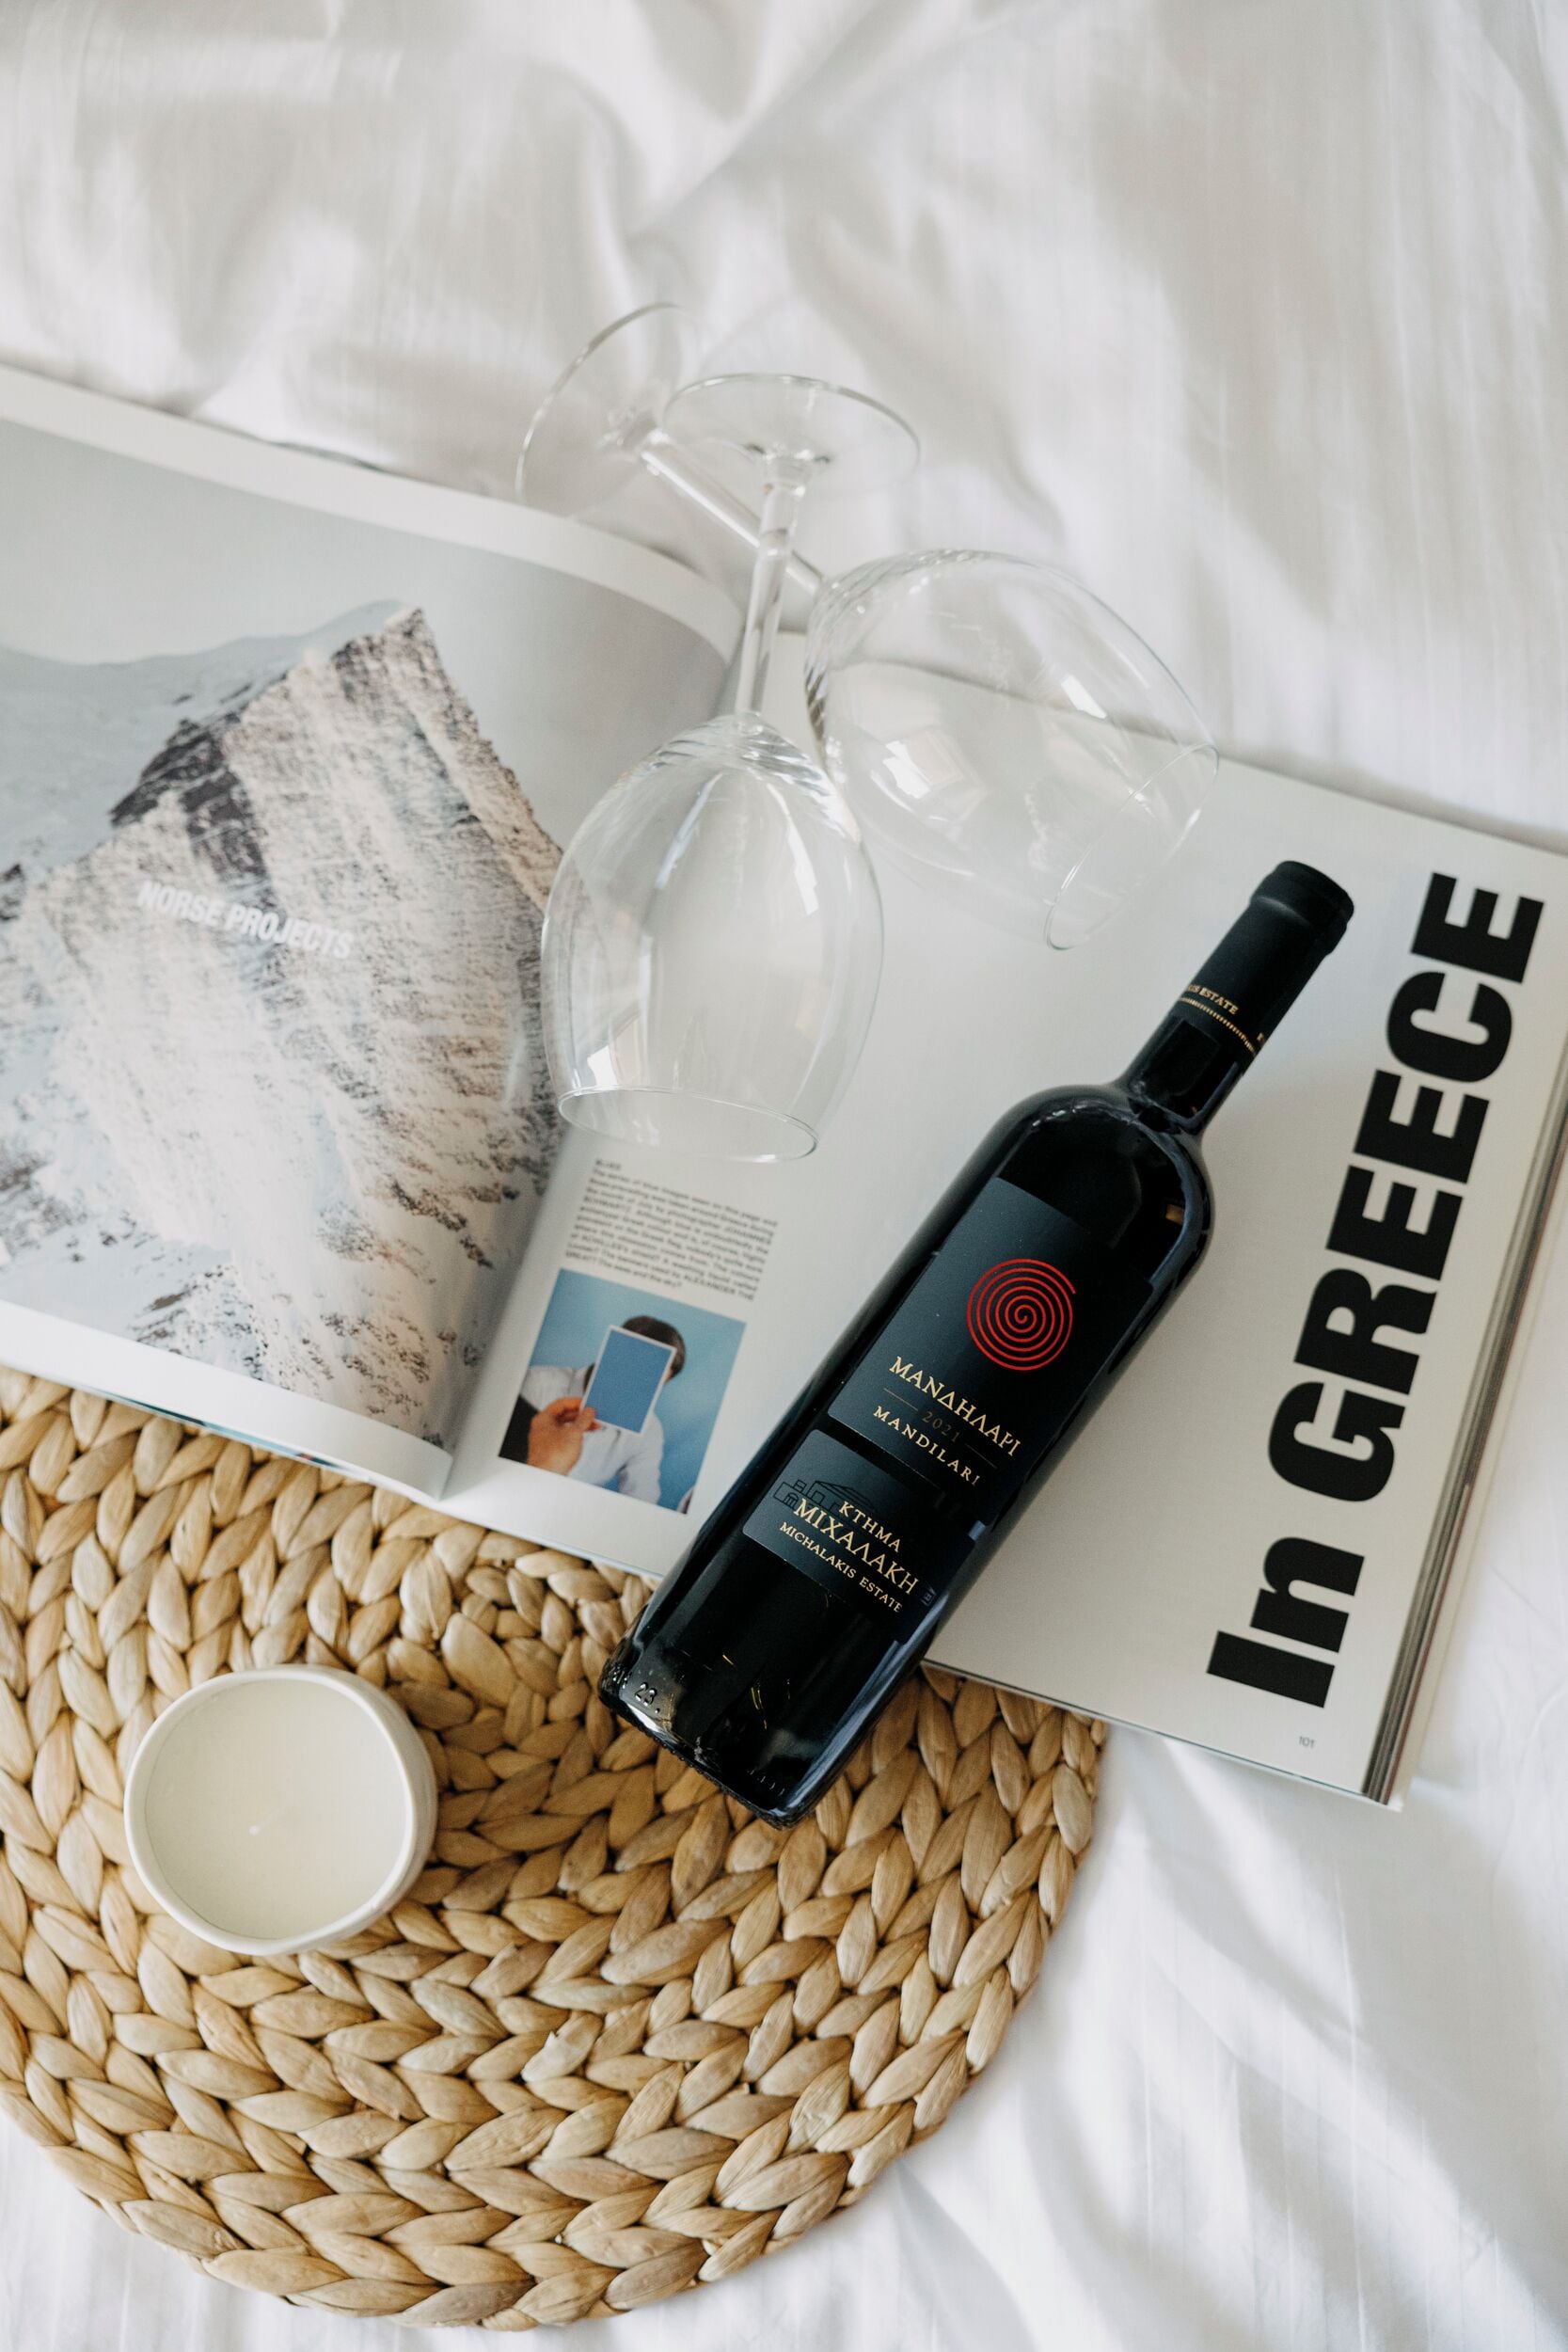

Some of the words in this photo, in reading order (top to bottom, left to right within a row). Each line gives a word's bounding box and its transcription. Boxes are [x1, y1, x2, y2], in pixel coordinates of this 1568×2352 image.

[137, 880, 225, 927] NORSE
[225, 903, 354, 959] PROJECTS
[1199, 988, 1239, 1014] ESTATE
[1268, 872, 1544, 1502] GREECE
[873, 1406, 980, 1486] MANDILARI
[921, 1411, 960, 1442] 2021
[780, 1521, 857, 1579] MICHALAKIS
[859, 1577, 903, 1613] ESTATE
[793, 1499, 919, 1595] ΜΙΧΑΛΑΚΗ
[839, 1502, 901, 1552] ΚΤΗΜΑ
[1207, 1535, 1365, 1708] In
